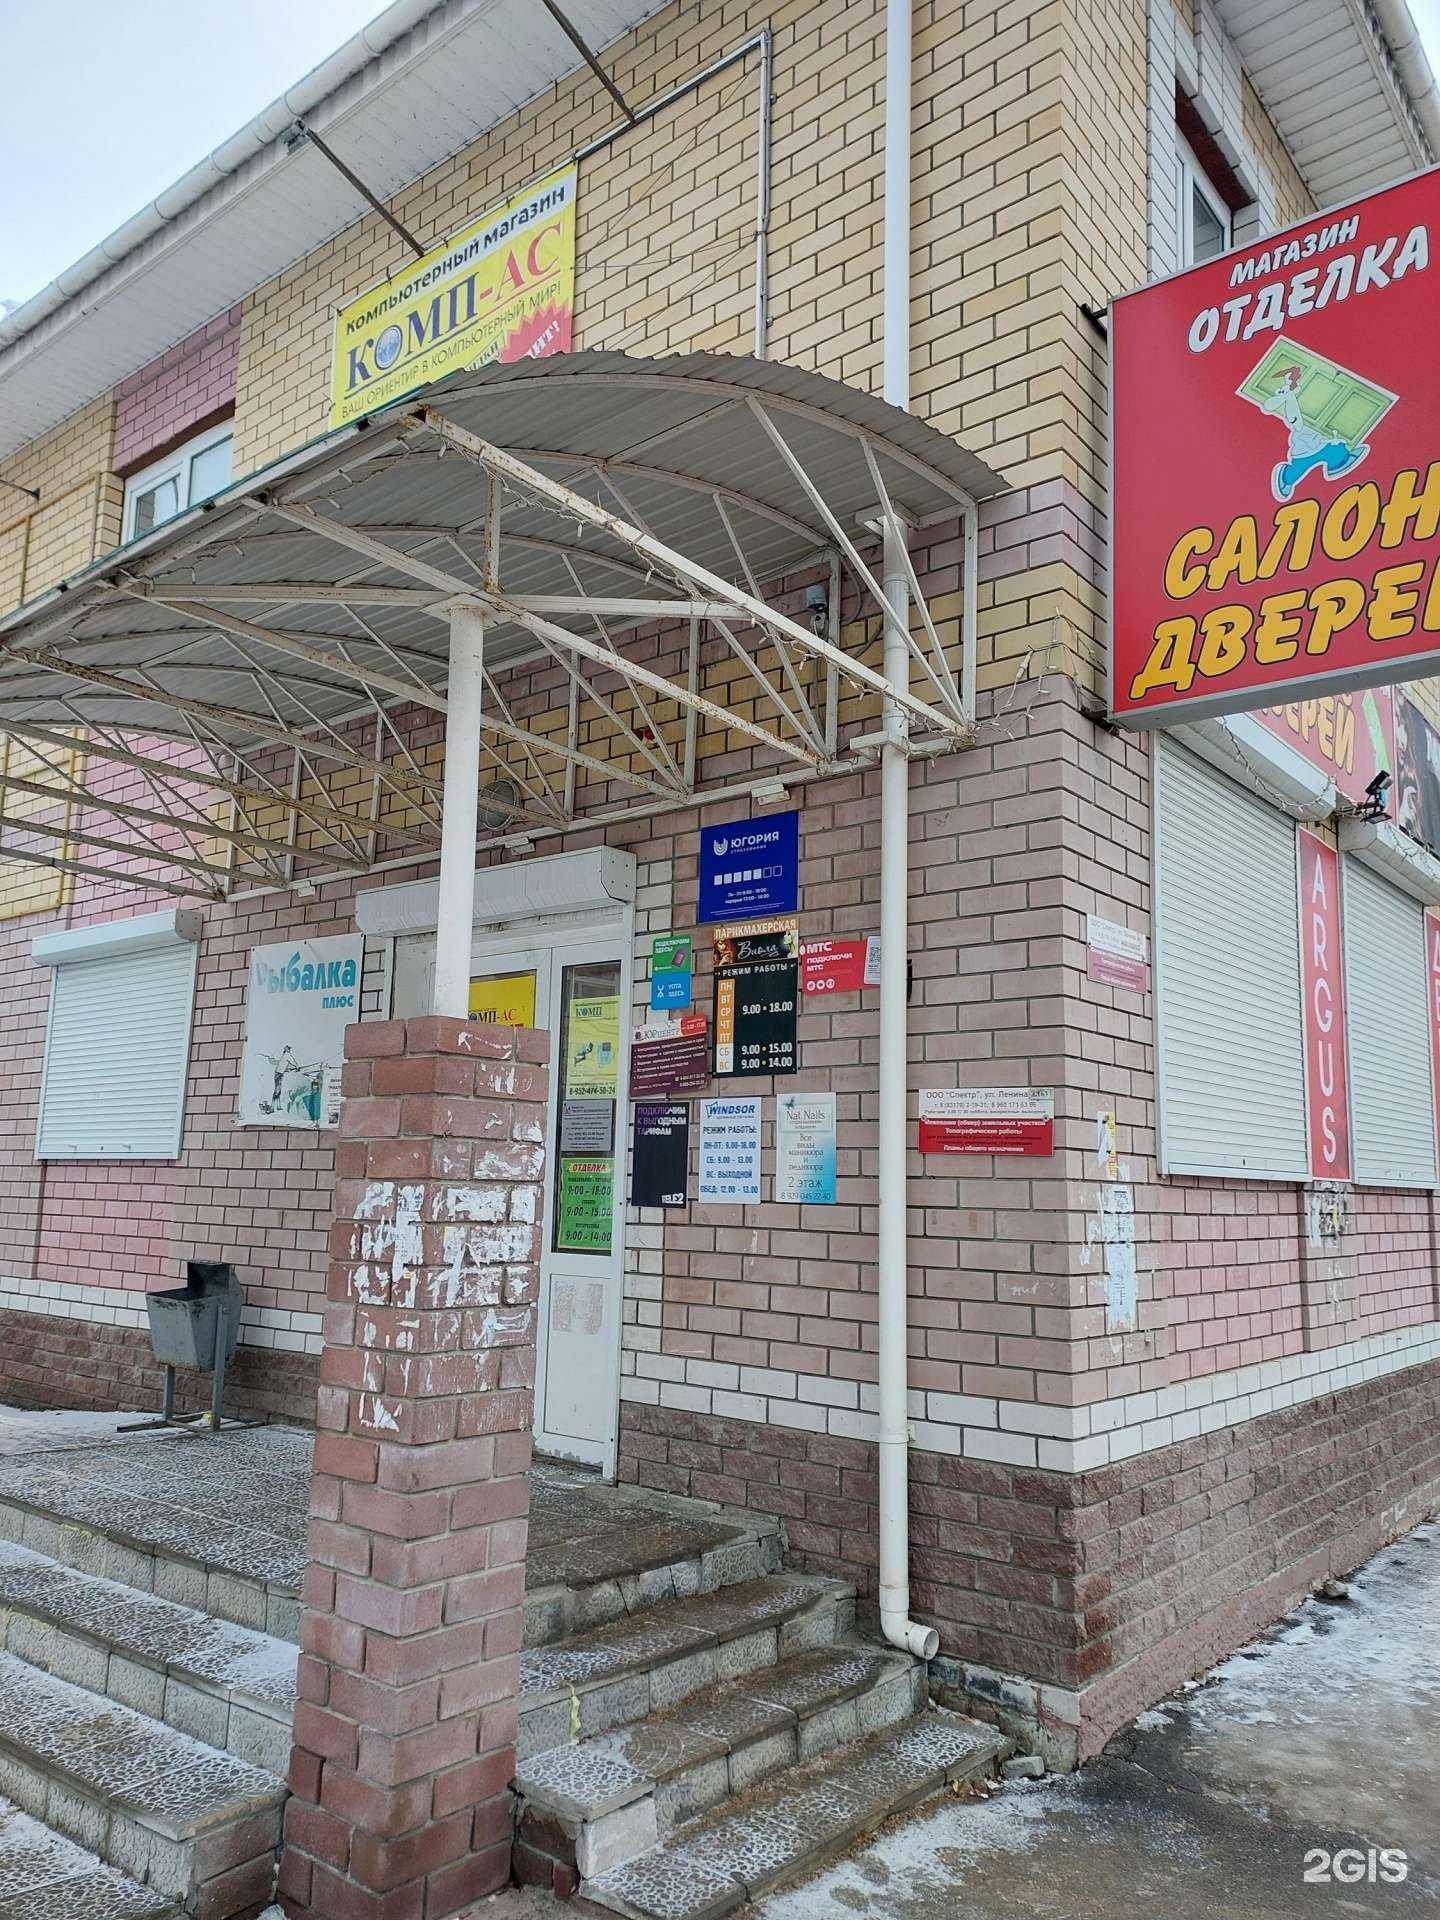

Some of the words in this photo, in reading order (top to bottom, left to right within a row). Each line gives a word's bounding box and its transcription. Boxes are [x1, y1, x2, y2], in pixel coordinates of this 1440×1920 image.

[1229, 215, 1361, 289] МАГАЗИН
[346, 241, 480, 335] компьютерный
[484, 186, 565, 249] магазин
[1186, 225, 1430, 354] ОТДЕЛКА
[345, 221, 562, 392] КОМП-АС
[341, 395, 364, 418] ВАШ
[366, 365, 420, 404] ОРИЕНТИР
[422, 360, 428, 374] В
[431, 299, 525, 368] КОМПЬЮТЕРНЫЙ
[530, 280, 561, 307] МИР!
[1165, 458, 1440, 600] САЛОН
[731, 831, 779, 848] ЮГОРИЯ
[715, 919, 797, 940] ПАРИКМАХЕРСКАЯ
[806, 941, 833, 954] МТС
[806, 953, 853, 964] ПОДКЛЮЧИ
[723, 966, 751, 977] РЕЖИМ
[754, 963, 788, 974] РАБОТЫ
[806, 964, 824, 972] МТС
[720, 981, 733, 991] ПН
[720, 994, 731, 1004] ВТ
[720, 1007, 732, 1017] СР
[742, 1004, 761, 1015] 9.00
[769, 1001, 793, 1013] 18.00
[1311, 852, 1338, 1164] ARGUS
[469, 1009, 517, 1023] ОМП-АС
[720, 1019, 731, 1029] ЧТ
[719, 1032, 731, 1043] ПТ
[719, 1047, 730, 1057] СБ
[742, 1044, 760, 1055] 9.00
[769, 1042, 793, 1054] 15.00
[719, 1060, 730, 1071] ВС
[742, 1058, 760, 1069] 9.00
[769, 1056, 793, 1067] 14.00
[638, 1105, 686, 1115] ПОДКЛЮЧИМ
[708, 1104, 755, 1117] WINDSOR
[787, 1111, 801, 1120] Nat
[806, 1110, 826, 1120] Nails
[638, 1118, 643, 1126] К
[645, 1116, 687, 1126] ВЫГОДНЫМ
[638, 1127, 672, 1136] ТАРИФАМ
[703, 1126, 726, 1135] РЕЖИМ
[728, 1126, 757, 1134] РАБОТЫ:
[572, 1163, 608, 1172] ОТДЕЛКА
[717, 1169, 753, 1179] ВЫХОДНОЙ
[788, 1177, 795, 1188] 2
[798, 1178, 823, 1188] этаж
[568, 1185, 584, 1195] 9:00
[591, 1185, 611, 1195] 18:00
[662, 1192, 684, 1205] TELE2
[566, 1207, 583, 1216] 9:00
[566, 1231, 583, 1241] 9:00
